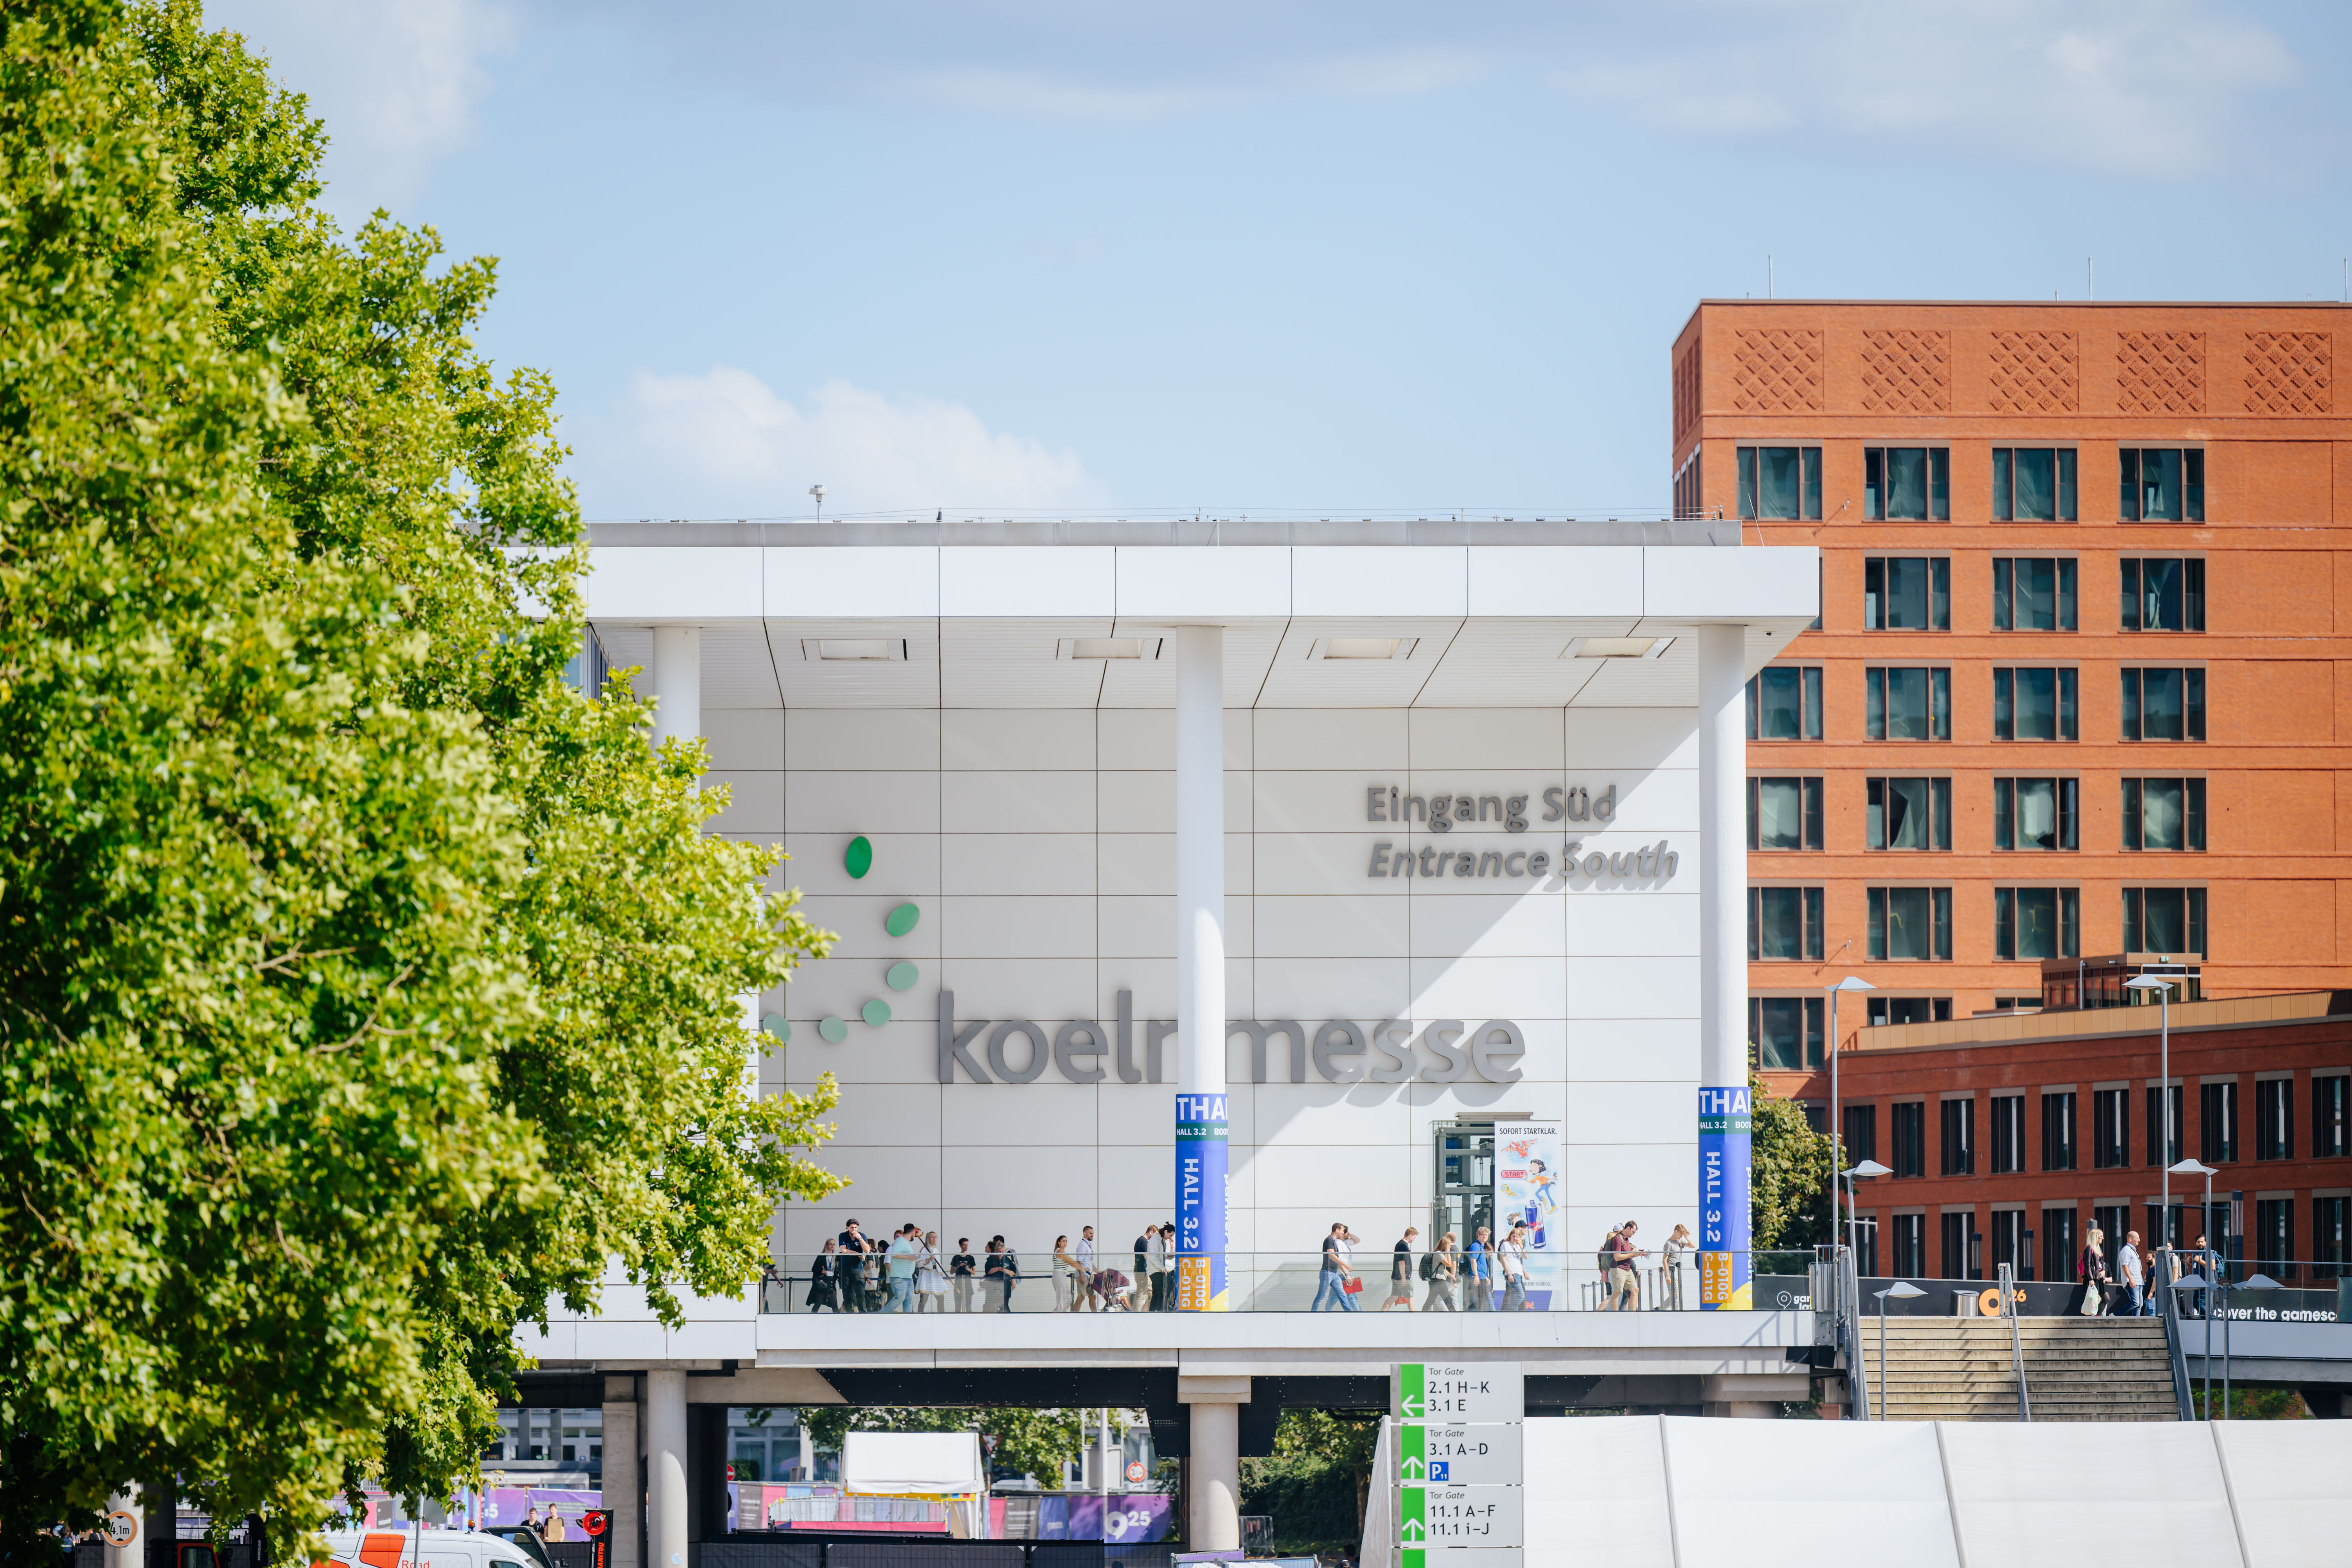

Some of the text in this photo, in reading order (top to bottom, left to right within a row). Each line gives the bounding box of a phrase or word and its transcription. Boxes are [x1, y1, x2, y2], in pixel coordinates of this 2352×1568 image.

[1367, 784, 1616, 833] Eingang Süd
[1368, 840, 1679, 877] Entrance South
[1183, 1159, 1198, 1249] HALL 3.2
[1706, 1152, 1720, 1243] HALL 3.2
[1181, 1259, 1191, 1307] C-011G
[1195, 1259, 1206, 1307] B-010G
[1704, 1253, 1713, 1300] C-011G
[1718, 1253, 1728, 1300] B-010G
[2255, 1307, 2277, 1320] the
[2281, 1309, 2337, 1321] gamesc
[1429, 1381, 1450, 1394] 2.1
[1429, 1399, 1466, 1411] 3.1 E
[1430, 1443, 1450, 1455] 3.1
[1430, 1505, 1459, 1517] 11.1
[1430, 1523, 1459, 1535] 11.1
